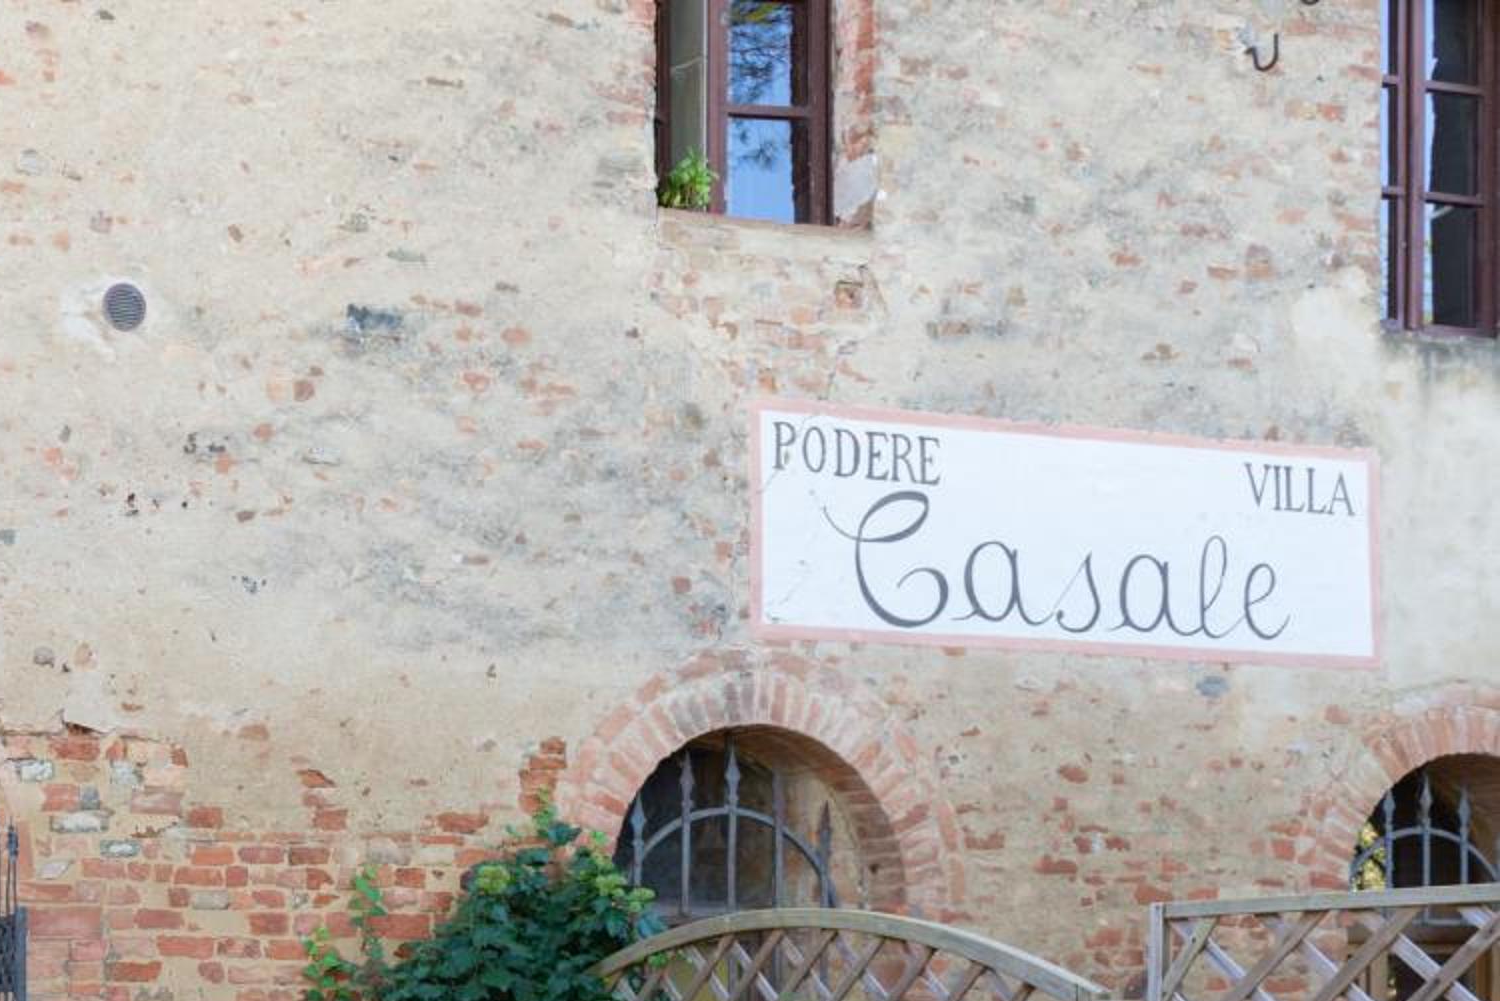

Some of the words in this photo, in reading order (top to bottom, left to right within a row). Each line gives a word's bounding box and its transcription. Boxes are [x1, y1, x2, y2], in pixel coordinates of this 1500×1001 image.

[773, 420, 941, 486] PODERE
[1245, 462, 1356, 517] VILLA
[822, 490, 1292, 640] Casale
